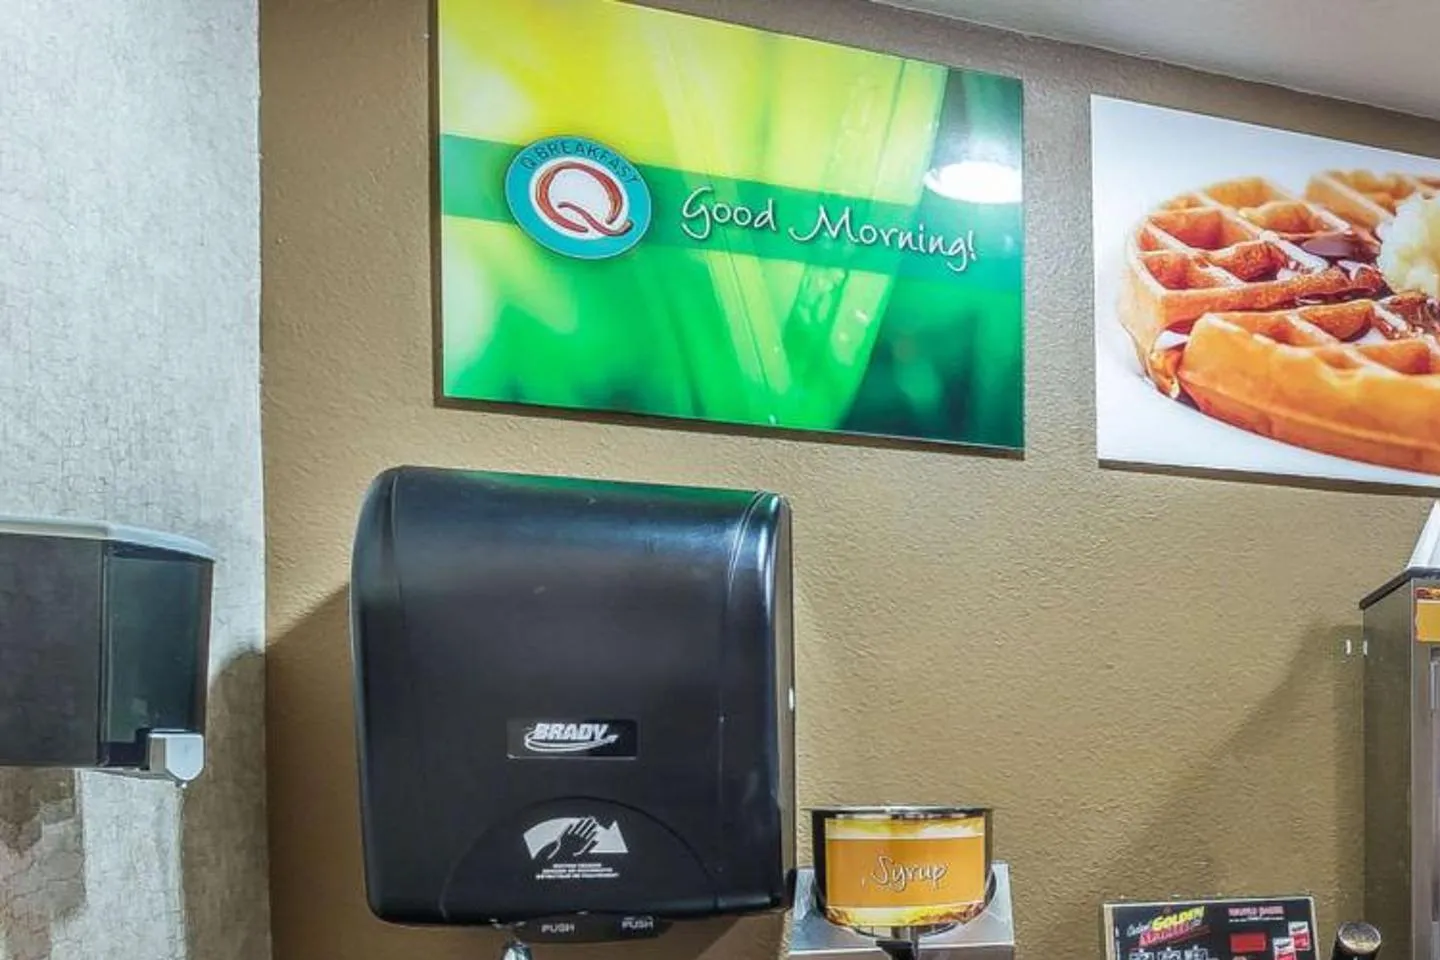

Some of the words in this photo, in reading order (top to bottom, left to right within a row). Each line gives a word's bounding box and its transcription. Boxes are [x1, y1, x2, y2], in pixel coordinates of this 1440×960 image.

[535, 160, 634, 237] Q
[682, 186, 777, 239] Good
[788, 206, 977, 272] Morning!
[532, 723, 609, 741] BRADY
[871, 855, 948, 893] Syrup
[541, 923, 575, 934] PUSH
[621, 918, 654, 930] PUSH
